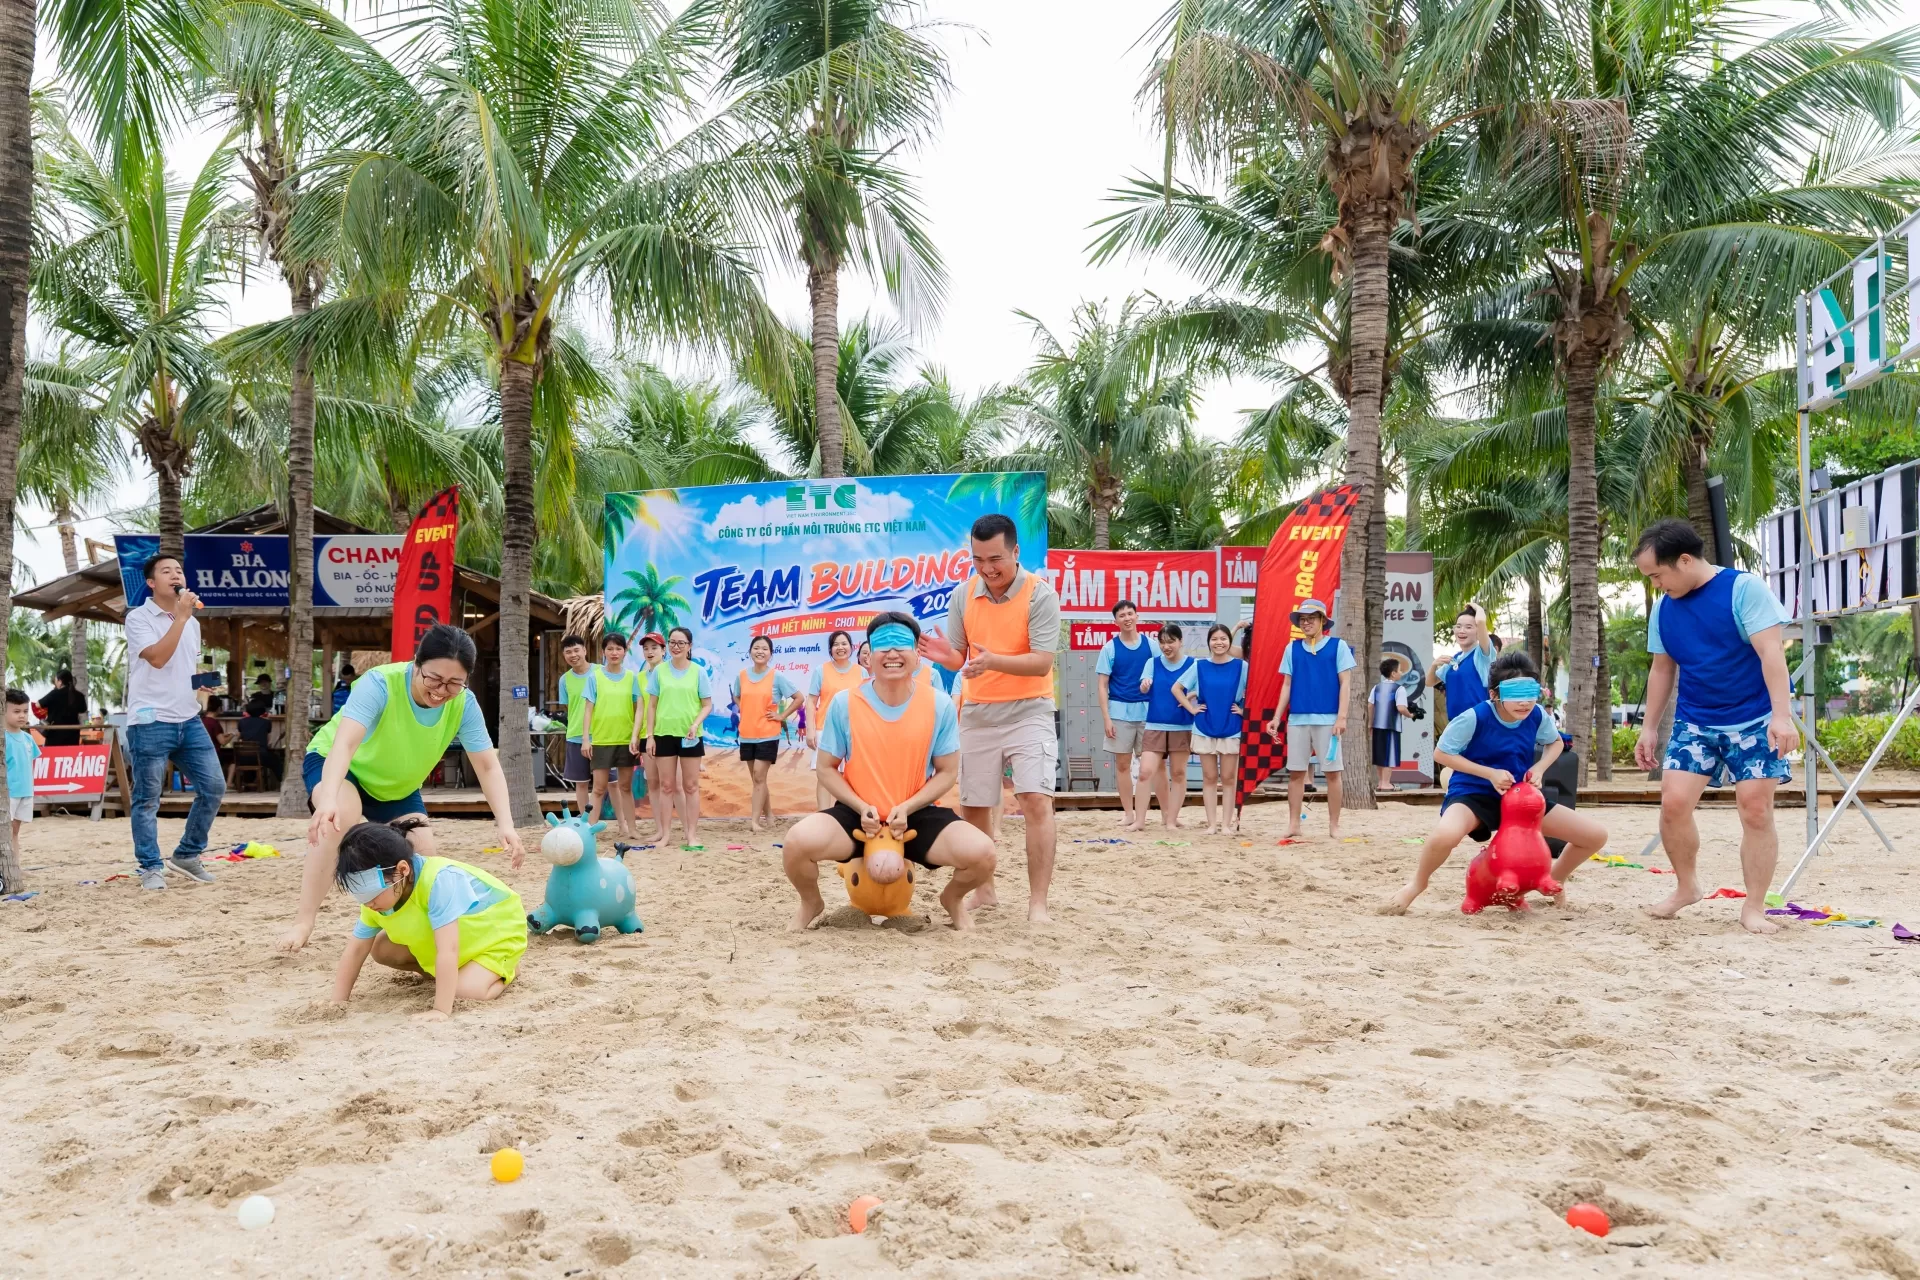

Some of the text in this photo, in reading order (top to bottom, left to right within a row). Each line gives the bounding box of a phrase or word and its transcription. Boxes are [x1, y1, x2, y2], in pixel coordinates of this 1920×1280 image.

[786, 484, 856, 511] ETC
[718, 519, 926, 539] CÔNG TY CỔ PHẦN MÔI TRƯỜNG ETC VIỆT NAM
[1289, 525, 1344, 541] EVENT
[231, 553, 266, 567] BIA
[418, 551, 441, 591] UP
[1225, 551, 1257, 583] TẮM
[333, 572, 351, 580] BIA
[363, 568, 379, 580] ỐC
[1114, 562, 1208, 608] TRÁNG
[1294, 550, 1319, 598] RACE
[694, 564, 800, 620] TEAM
[761, 624, 779, 636] LÀM
[781, 616, 799, 634] HẾT
[801, 617, 826, 630] MÌNH
[835, 617, 855, 627] CHƠI
[1075, 626, 1107, 646] TẮM
[799, 643, 821, 654] mạnh
[53, 752, 107, 779] TRÁNG
